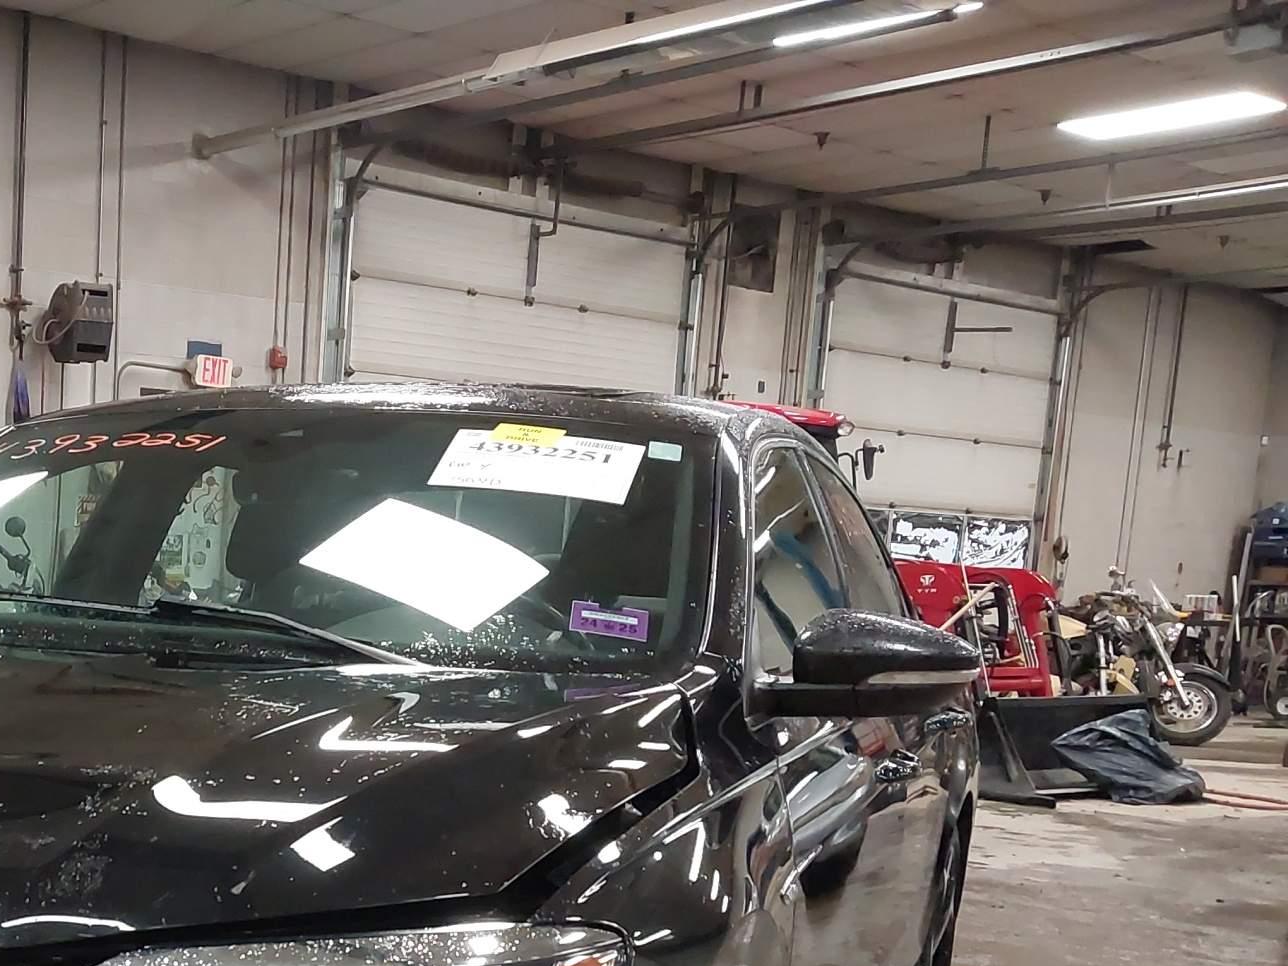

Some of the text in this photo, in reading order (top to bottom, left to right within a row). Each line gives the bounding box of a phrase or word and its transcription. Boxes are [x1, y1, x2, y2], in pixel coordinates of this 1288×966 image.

[202, 357, 229, 386] EXIT
[469, 441, 612, 464] 43932251
[580, 617, 597, 628] 24
[619, 623, 638, 634] 25
